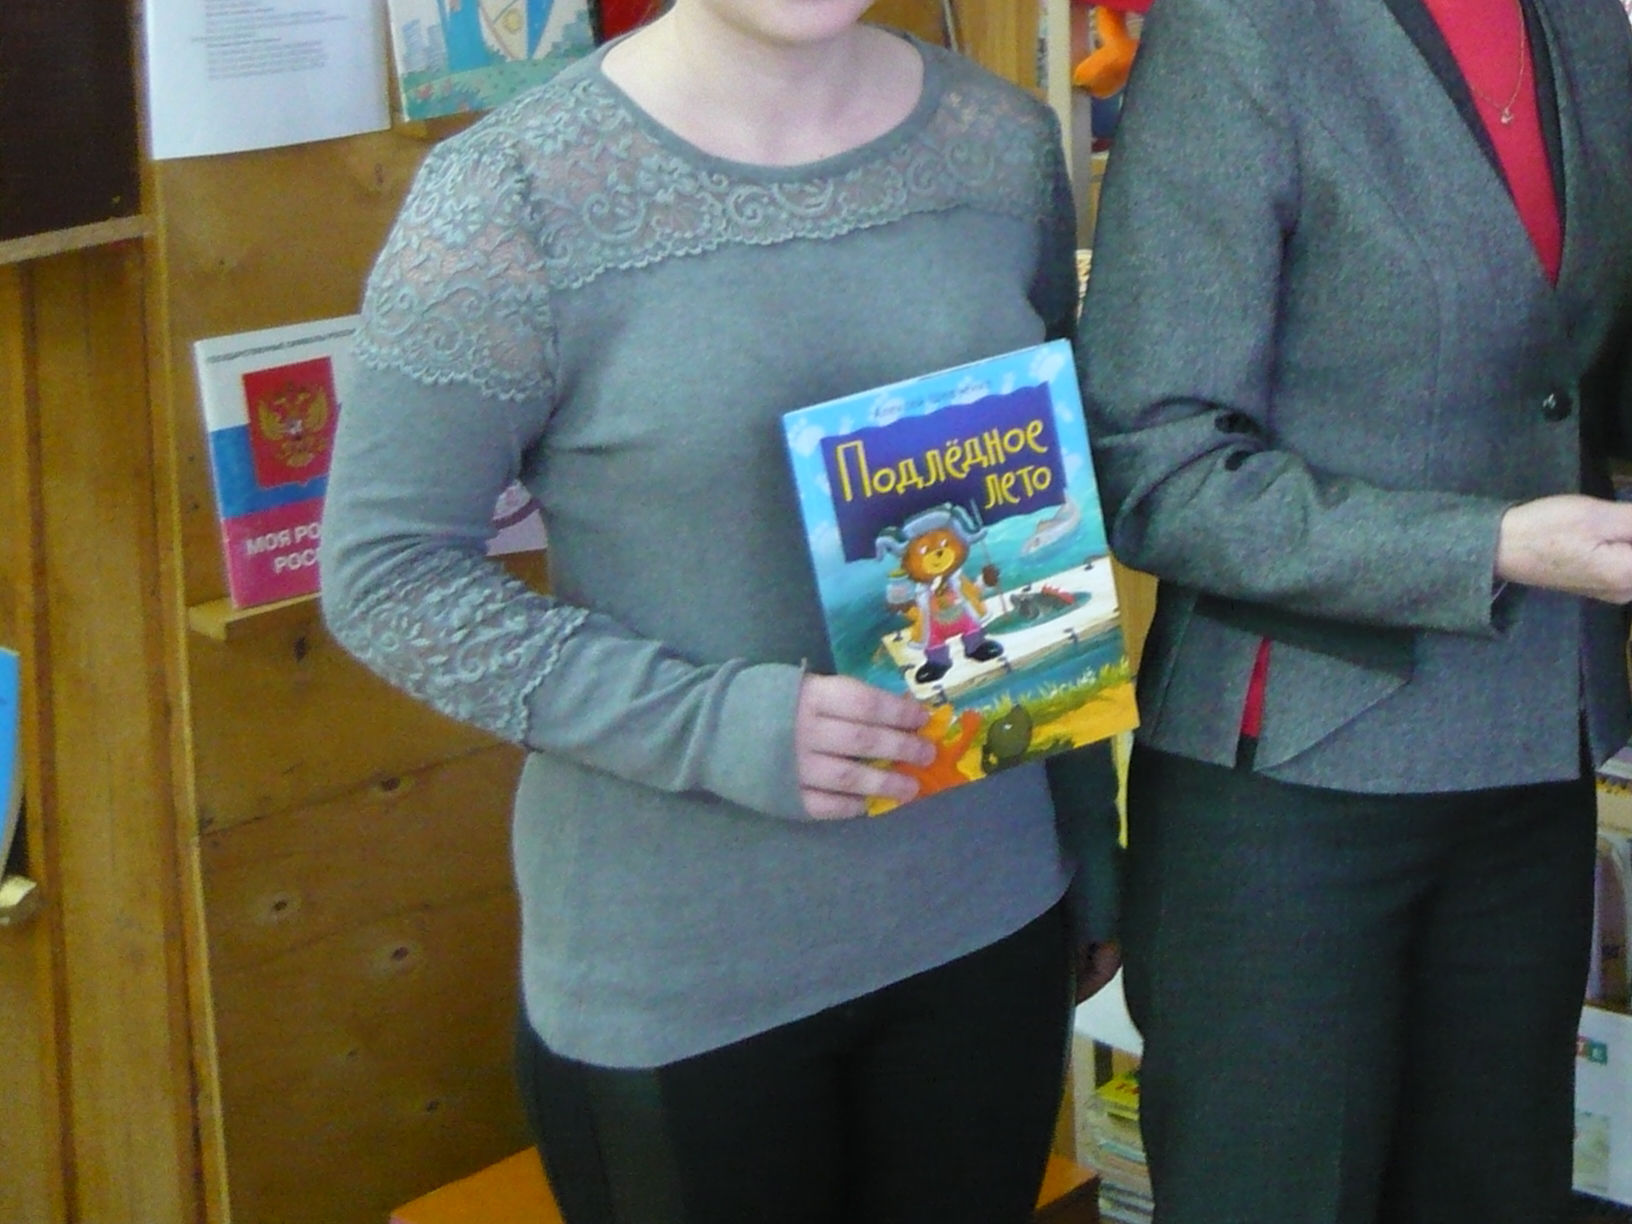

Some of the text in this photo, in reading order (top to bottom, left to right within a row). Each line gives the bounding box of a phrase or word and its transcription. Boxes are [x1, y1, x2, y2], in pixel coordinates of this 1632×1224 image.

[836, 419, 1049, 502] Подлёдное
[246, 529, 292, 555] МОЯ
[273, 547, 320, 575] РОС
